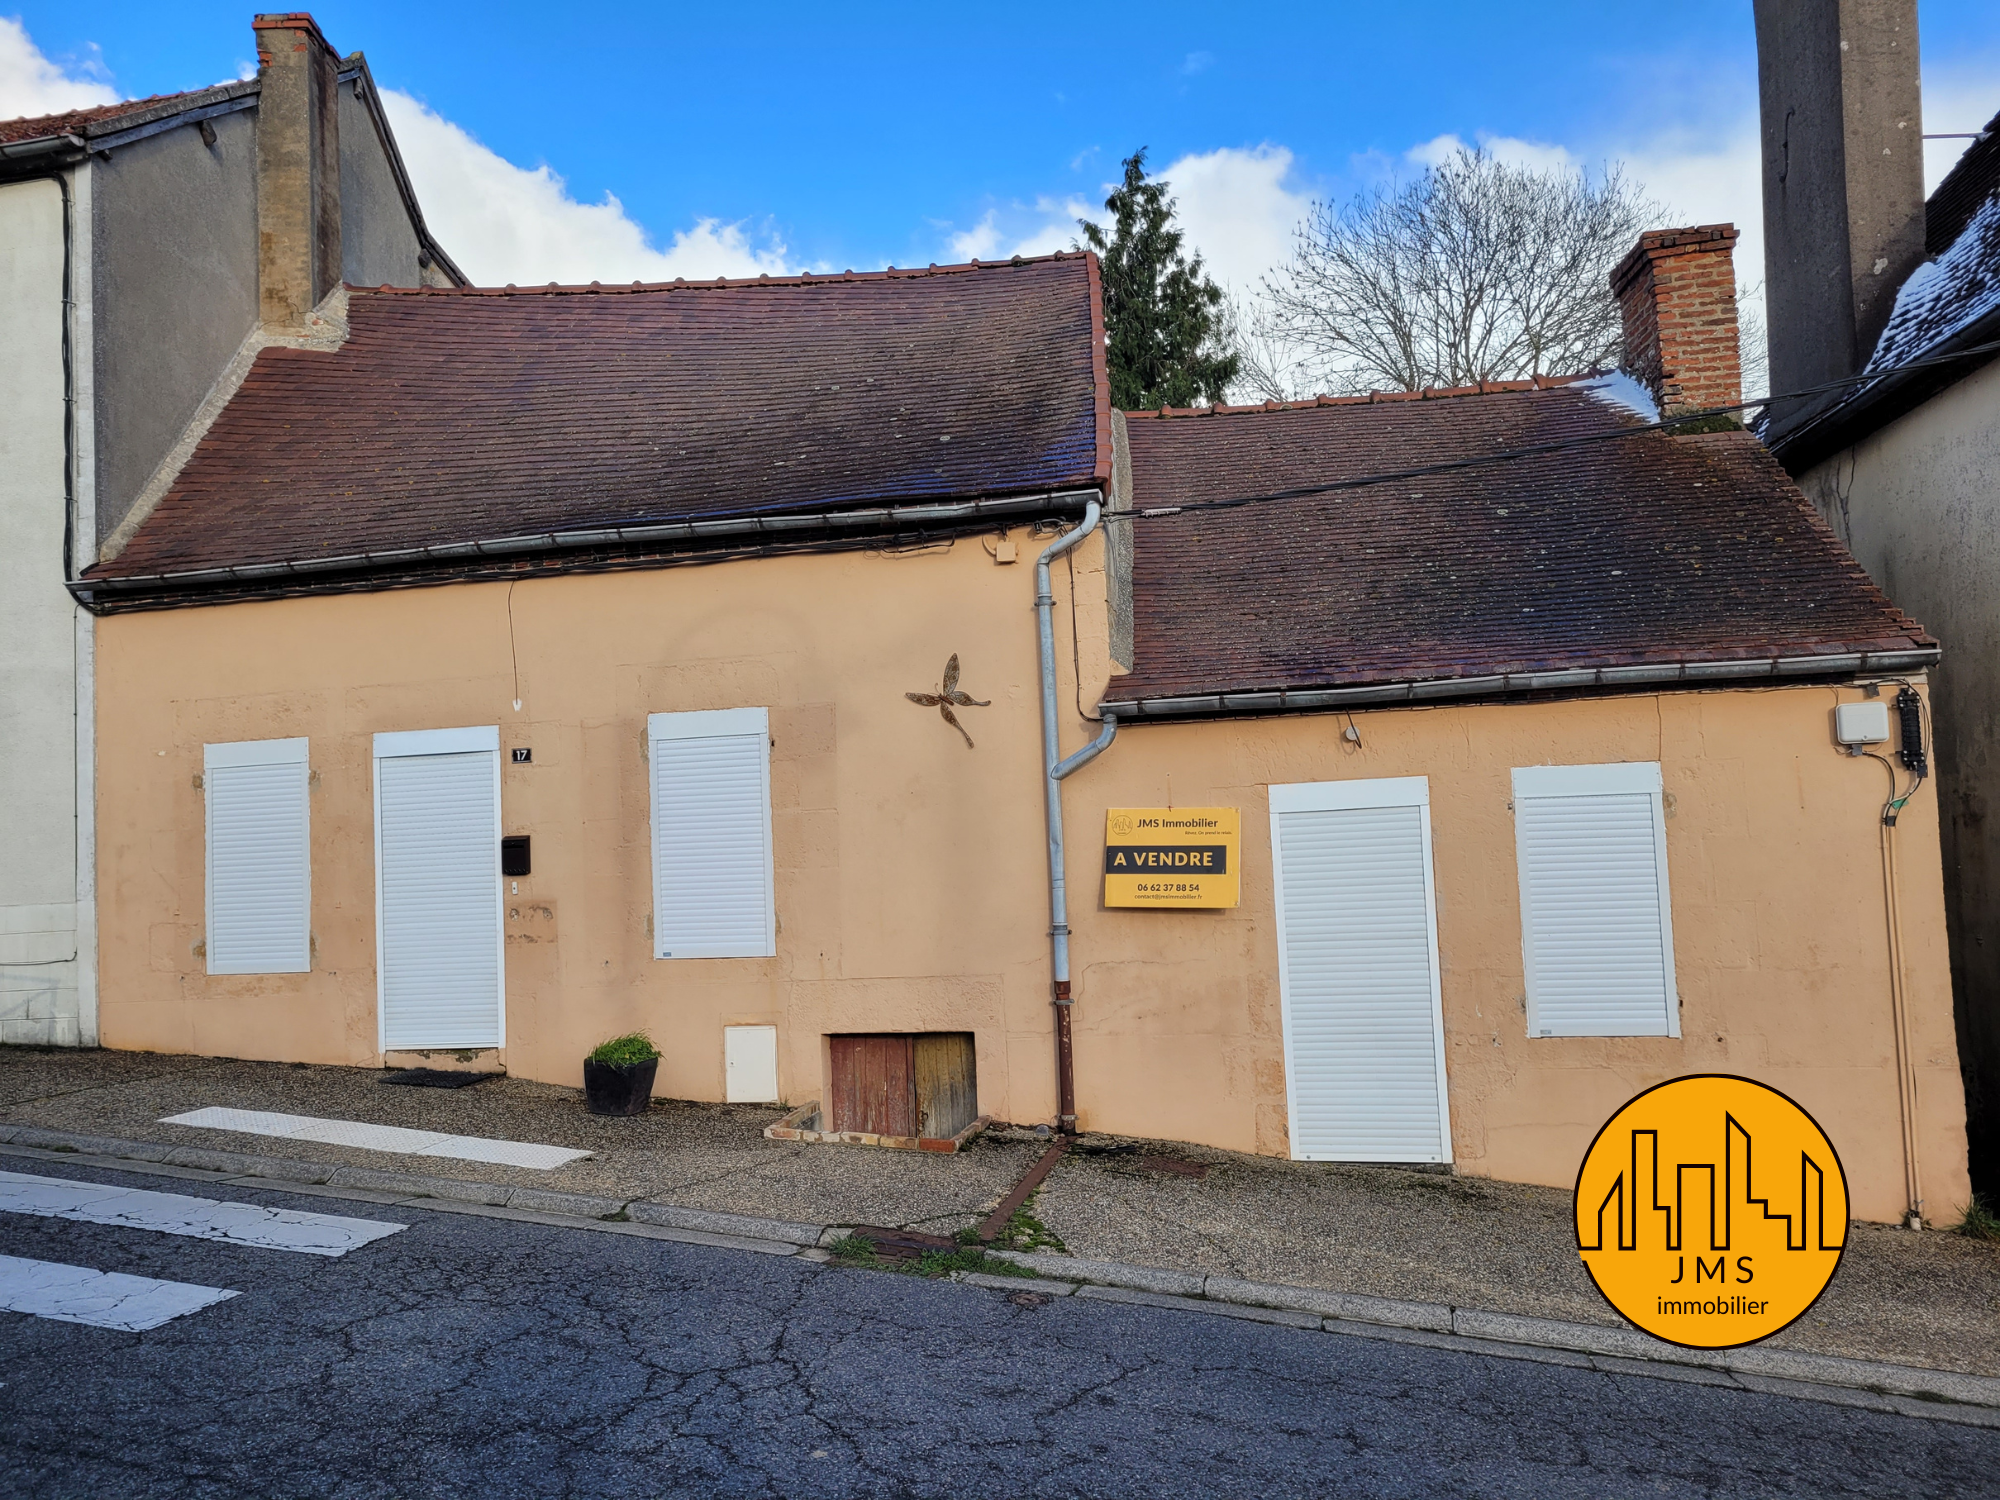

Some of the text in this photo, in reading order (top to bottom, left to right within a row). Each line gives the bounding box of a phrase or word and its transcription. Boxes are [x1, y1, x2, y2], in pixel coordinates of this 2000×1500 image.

[516, 750, 527, 761] 17
[1137, 818, 1219, 828] JMS Immobilier
[1114, 852, 1213, 867] A VENDRE
[1137, 883, 1200, 892] 06 62 37 88 54
